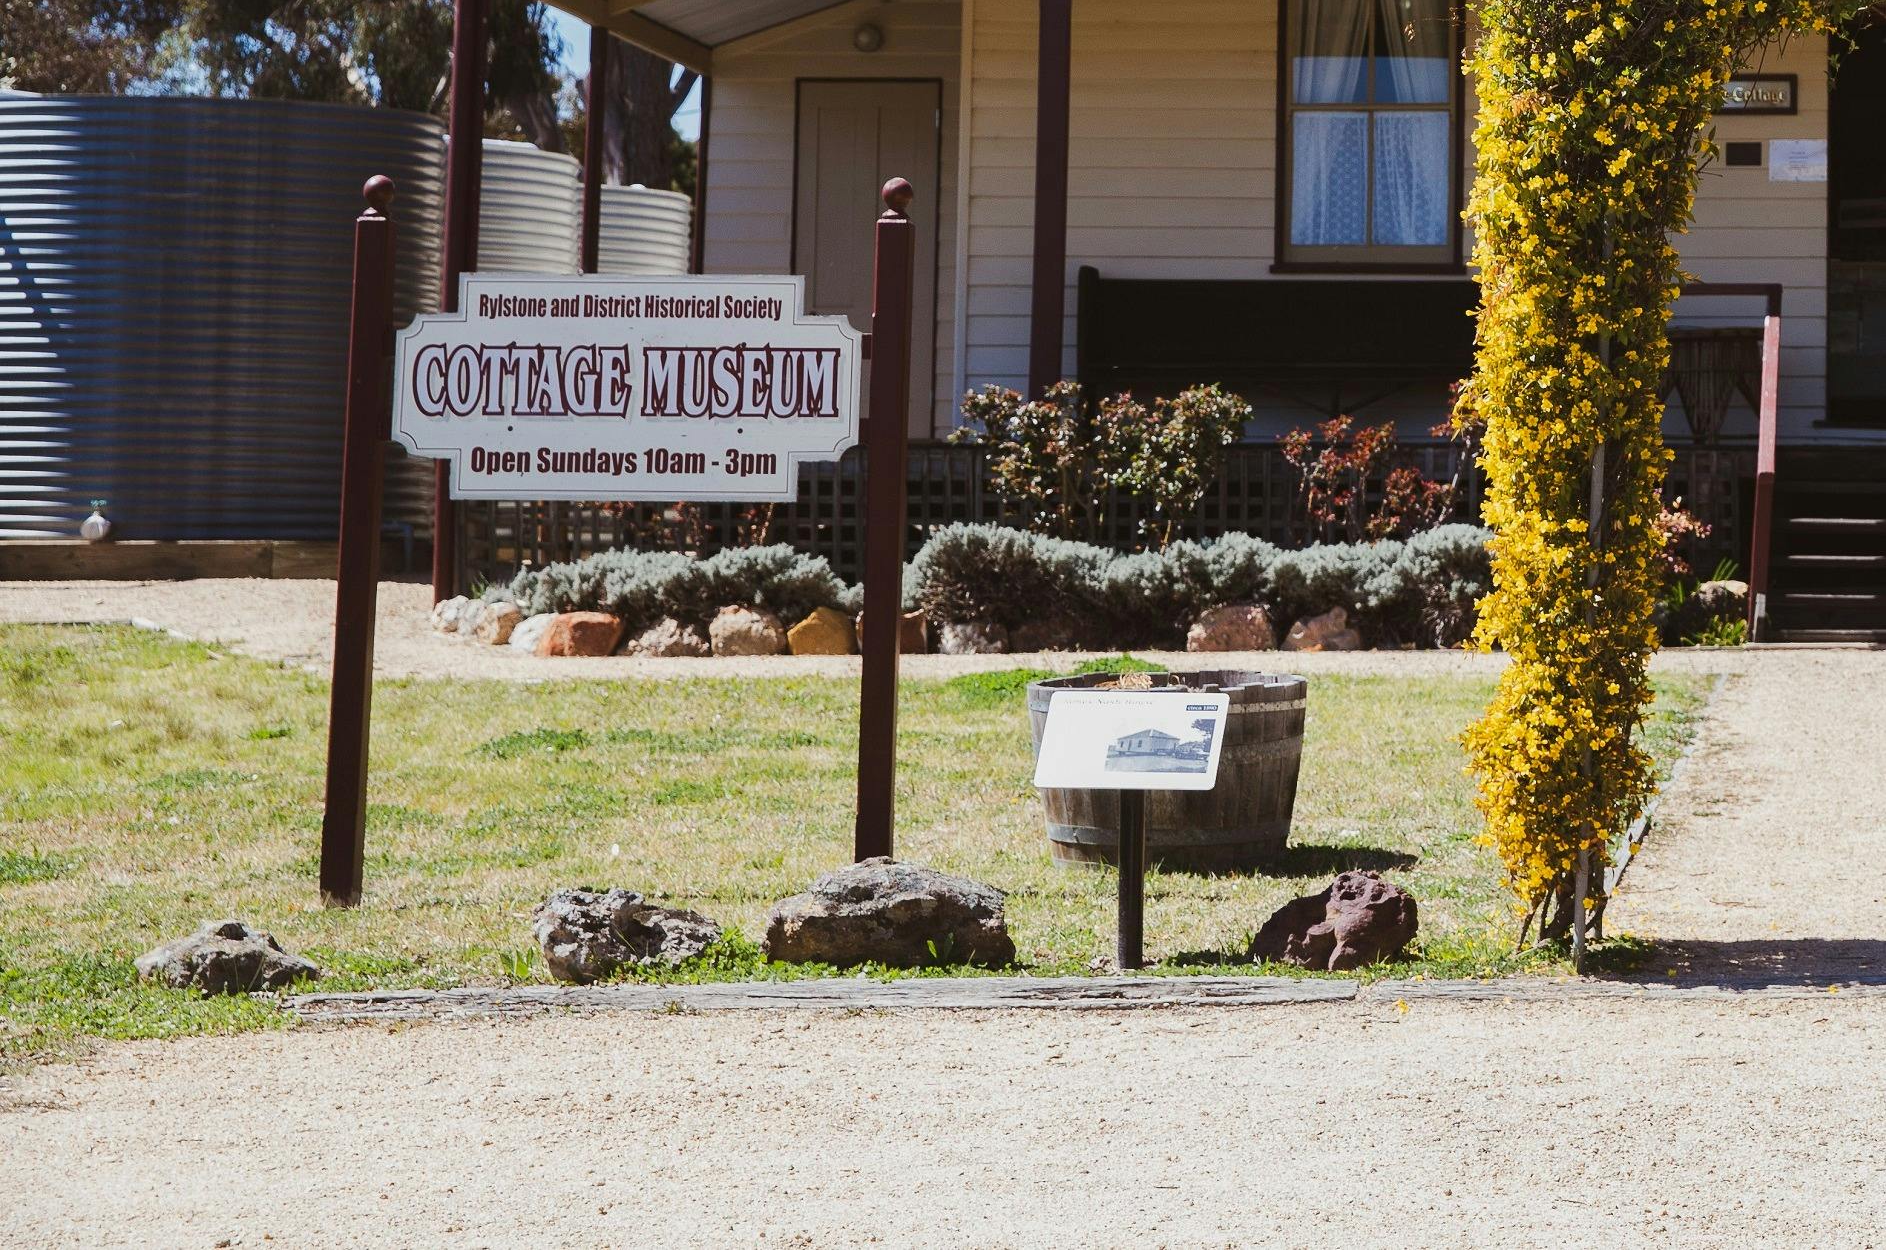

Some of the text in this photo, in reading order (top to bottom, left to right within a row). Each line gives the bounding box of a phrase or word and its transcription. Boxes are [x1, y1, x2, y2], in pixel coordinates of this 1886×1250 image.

[478, 293, 783, 321] Rylstone and District Historical Society
[412, 342, 842, 420] COTTAGE MUSEUM
[470, 447, 531, 476] Open
[537, 447, 638, 476] Sundays
[644, 448, 705, 475] 10am
[725, 448, 777, 477] 3pm
